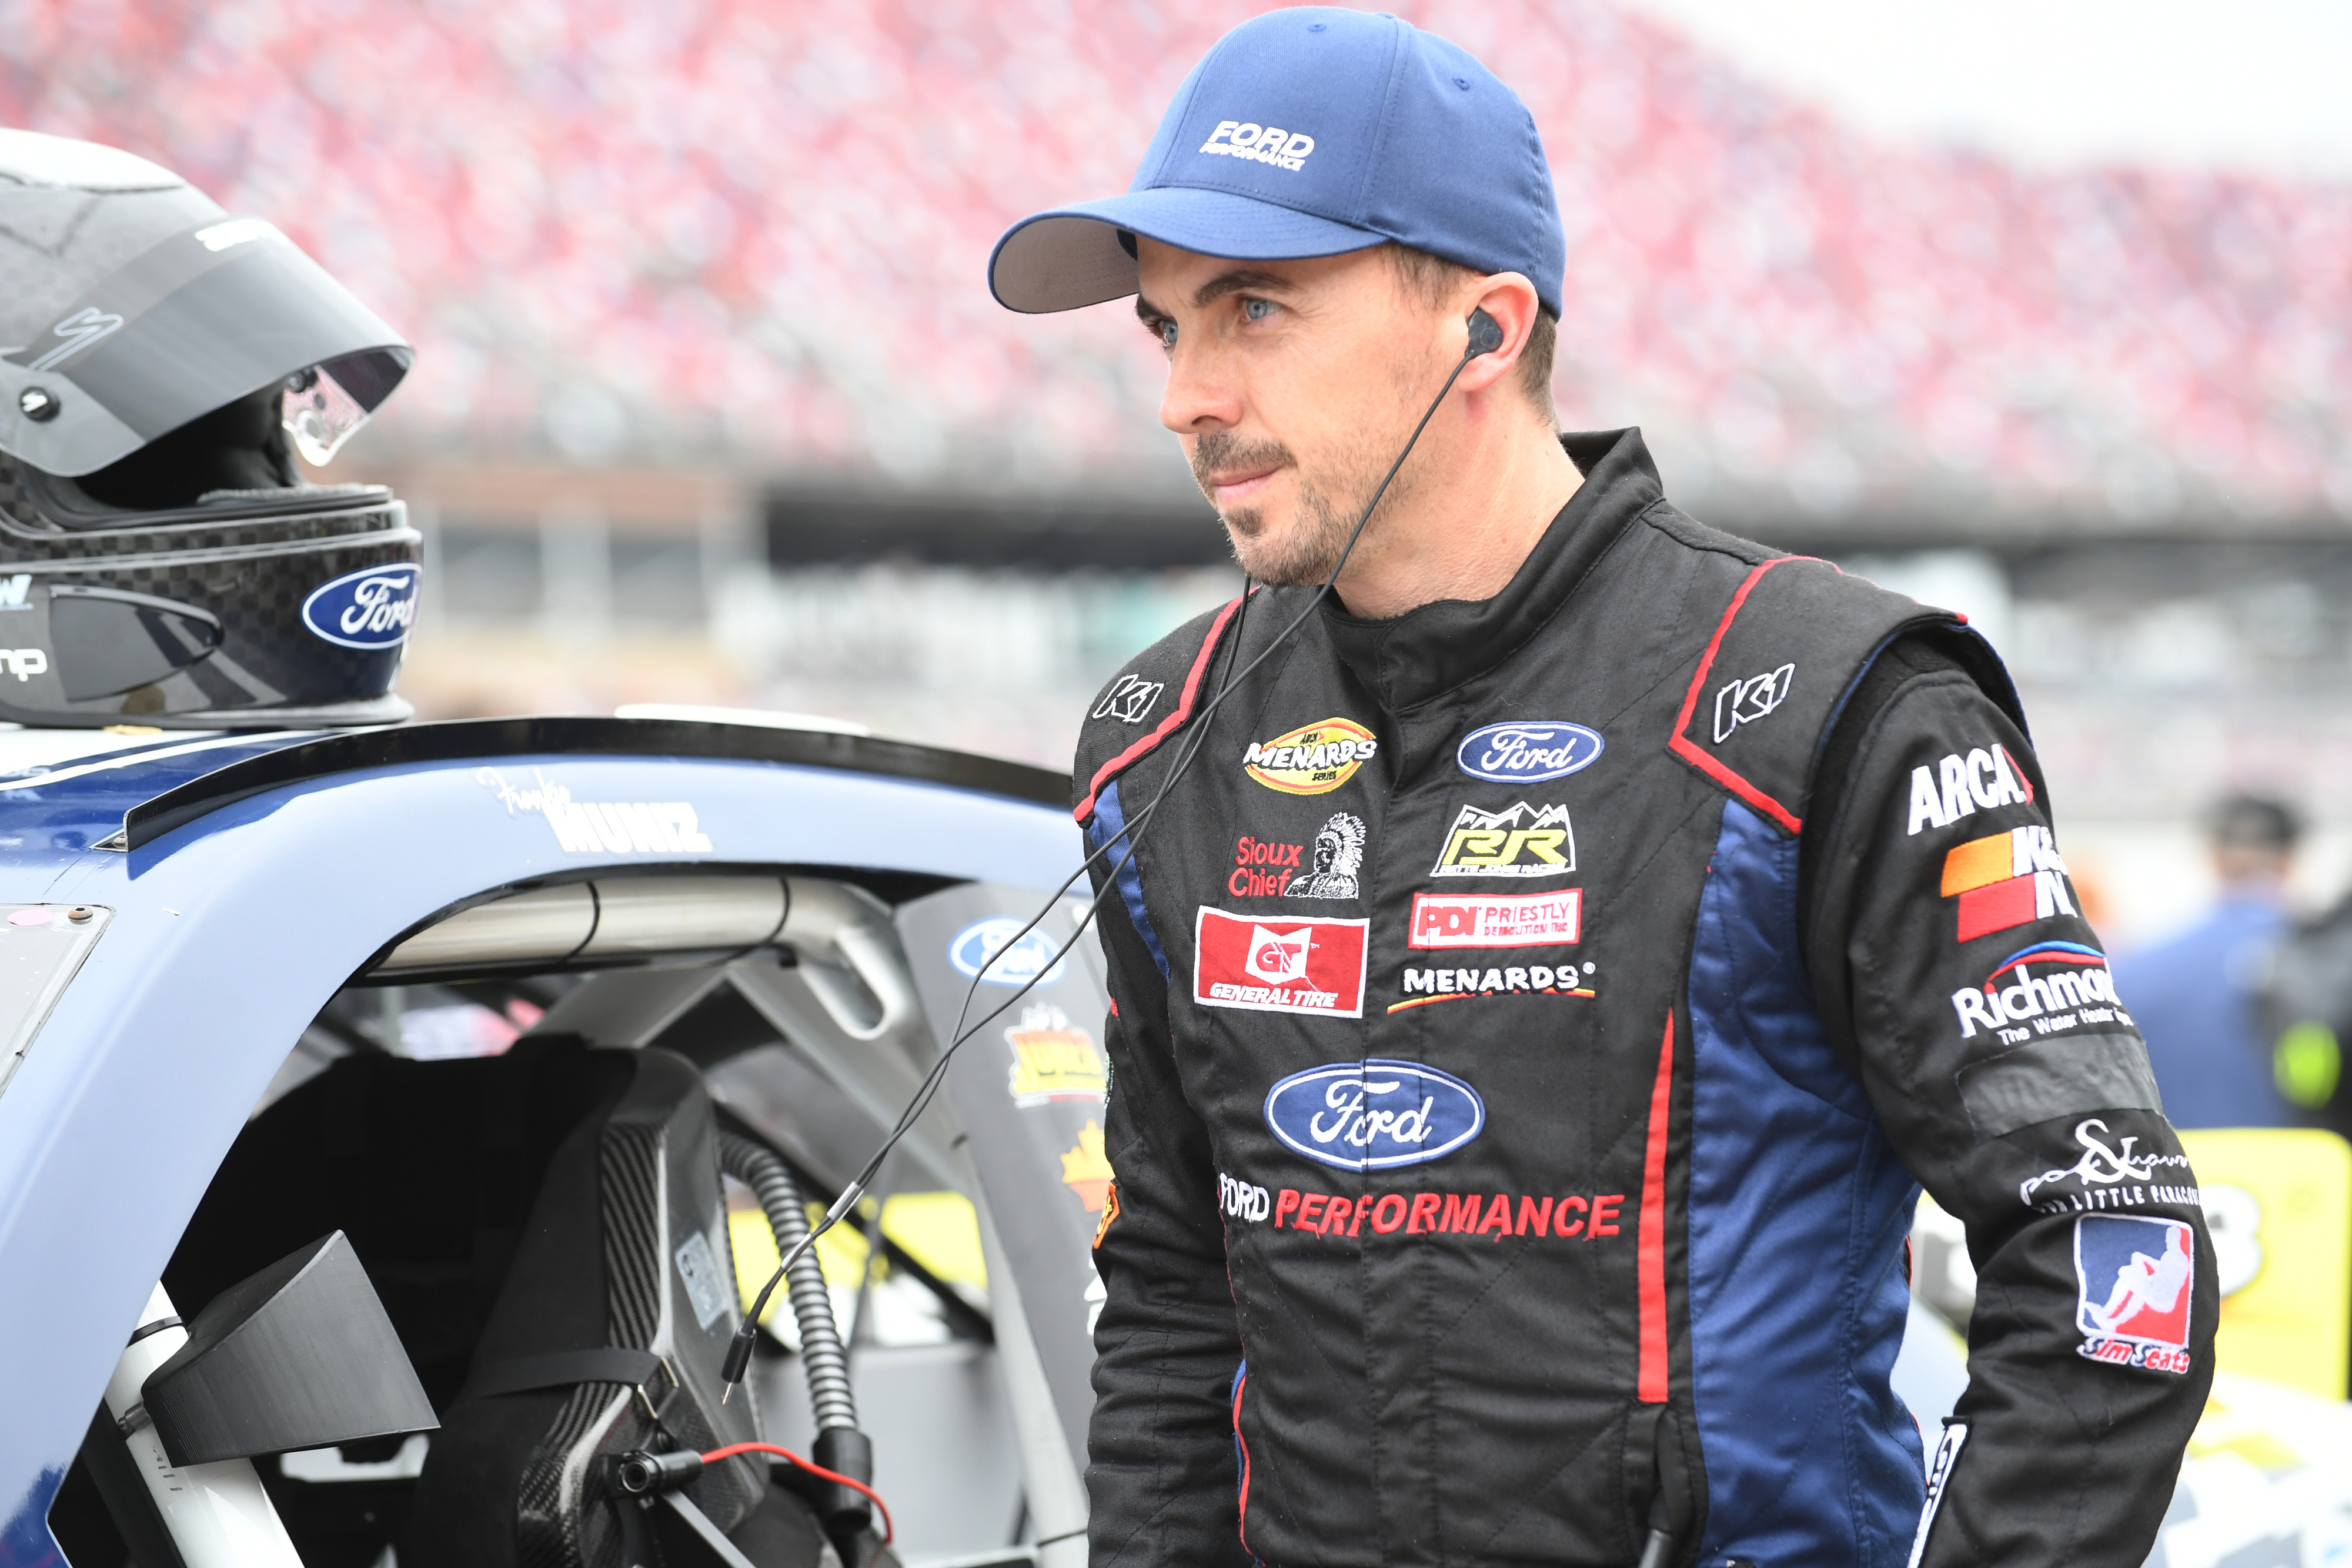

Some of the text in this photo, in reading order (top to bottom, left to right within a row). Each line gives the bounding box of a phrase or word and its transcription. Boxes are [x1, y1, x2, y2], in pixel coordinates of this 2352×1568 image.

[1207, 121, 1315, 158] FORD
[1199, 142, 1305, 171] PERFORMANCE
[1243, 740, 1377, 768] MENARDS
[1481, 730, 1577, 771] Ford
[1907, 743, 2027, 835] ARCA
[541, 802, 713, 854] MUNIZ
[1235, 836, 1304, 867] Sioux
[1228, 867, 1293, 897] Chief
[1484, 902, 1570, 923] PRIESTLY
[1210, 982, 1338, 1008] GENERAL TIRE
[1404, 965, 1579, 994] MENARDS
[1996, 1027, 2030, 1045] The
[2032, 1014, 2077, 1034] Water
[1310, 1078, 1434, 1147] Ford
[1220, 1172, 1625, 1238] FORD PERFORMANCE
